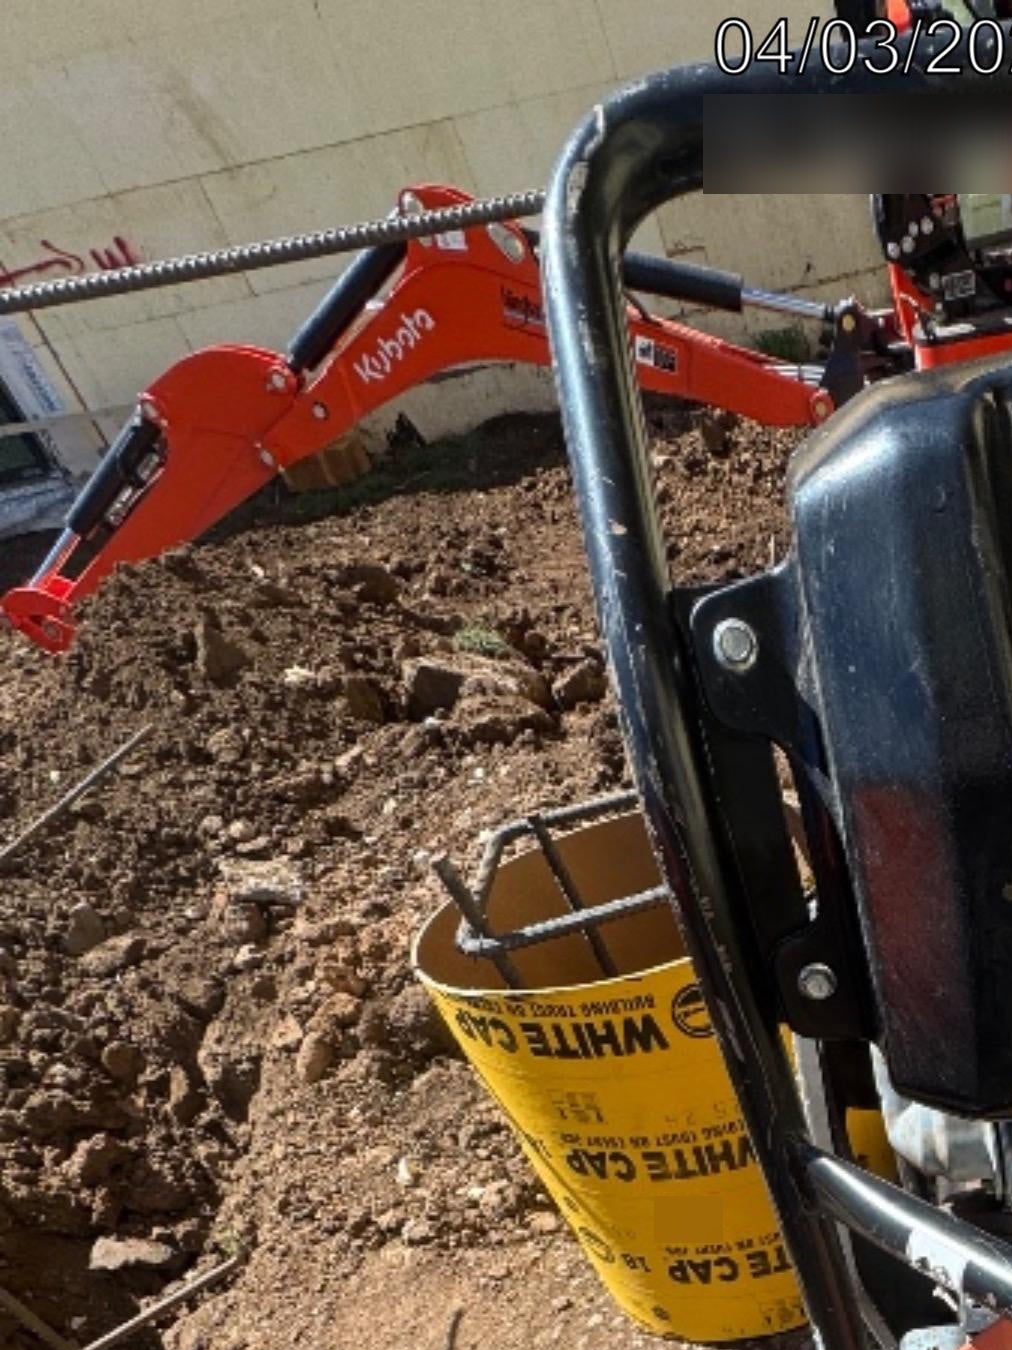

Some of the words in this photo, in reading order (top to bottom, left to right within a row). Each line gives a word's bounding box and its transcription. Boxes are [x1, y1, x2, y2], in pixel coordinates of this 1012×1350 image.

[353, 308, 435, 383] Kubota
[520, 1014, 669, 1059] WHITE
[566, 1148, 637, 1182] CAP
[668, 1255, 739, 1285] CAP
